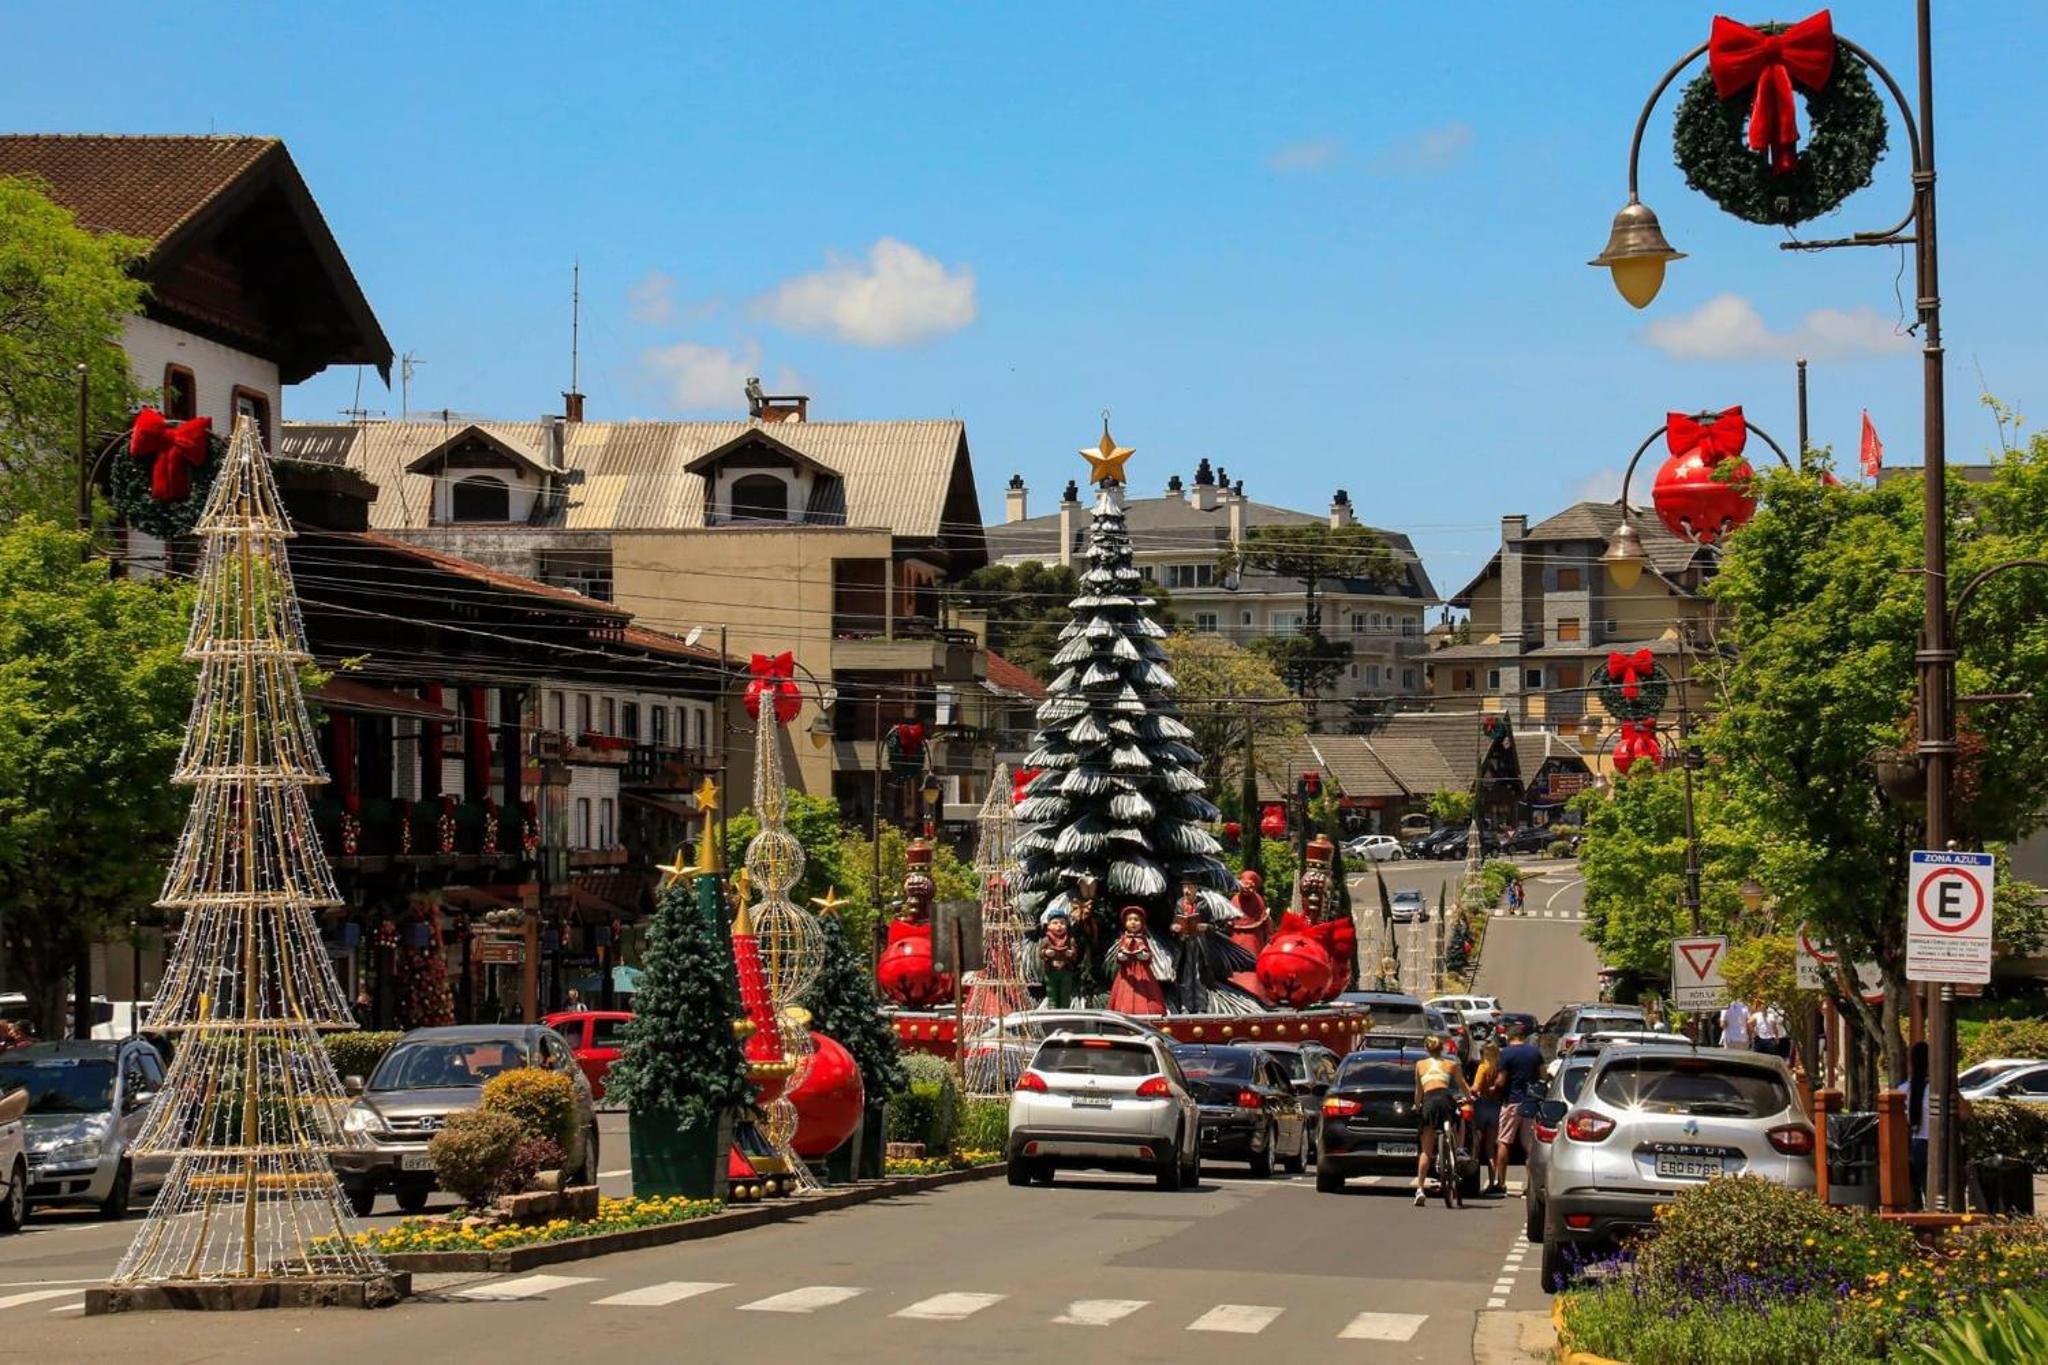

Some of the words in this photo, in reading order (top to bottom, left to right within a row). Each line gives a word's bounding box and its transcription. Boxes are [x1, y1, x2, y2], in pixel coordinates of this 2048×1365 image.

[1924, 854, 1952, 862] ZONA
[1954, 855, 1980, 864] AZUL
[1938, 882, 1963, 918] E
[1654, 1143, 1726, 1155] CAPTUR
